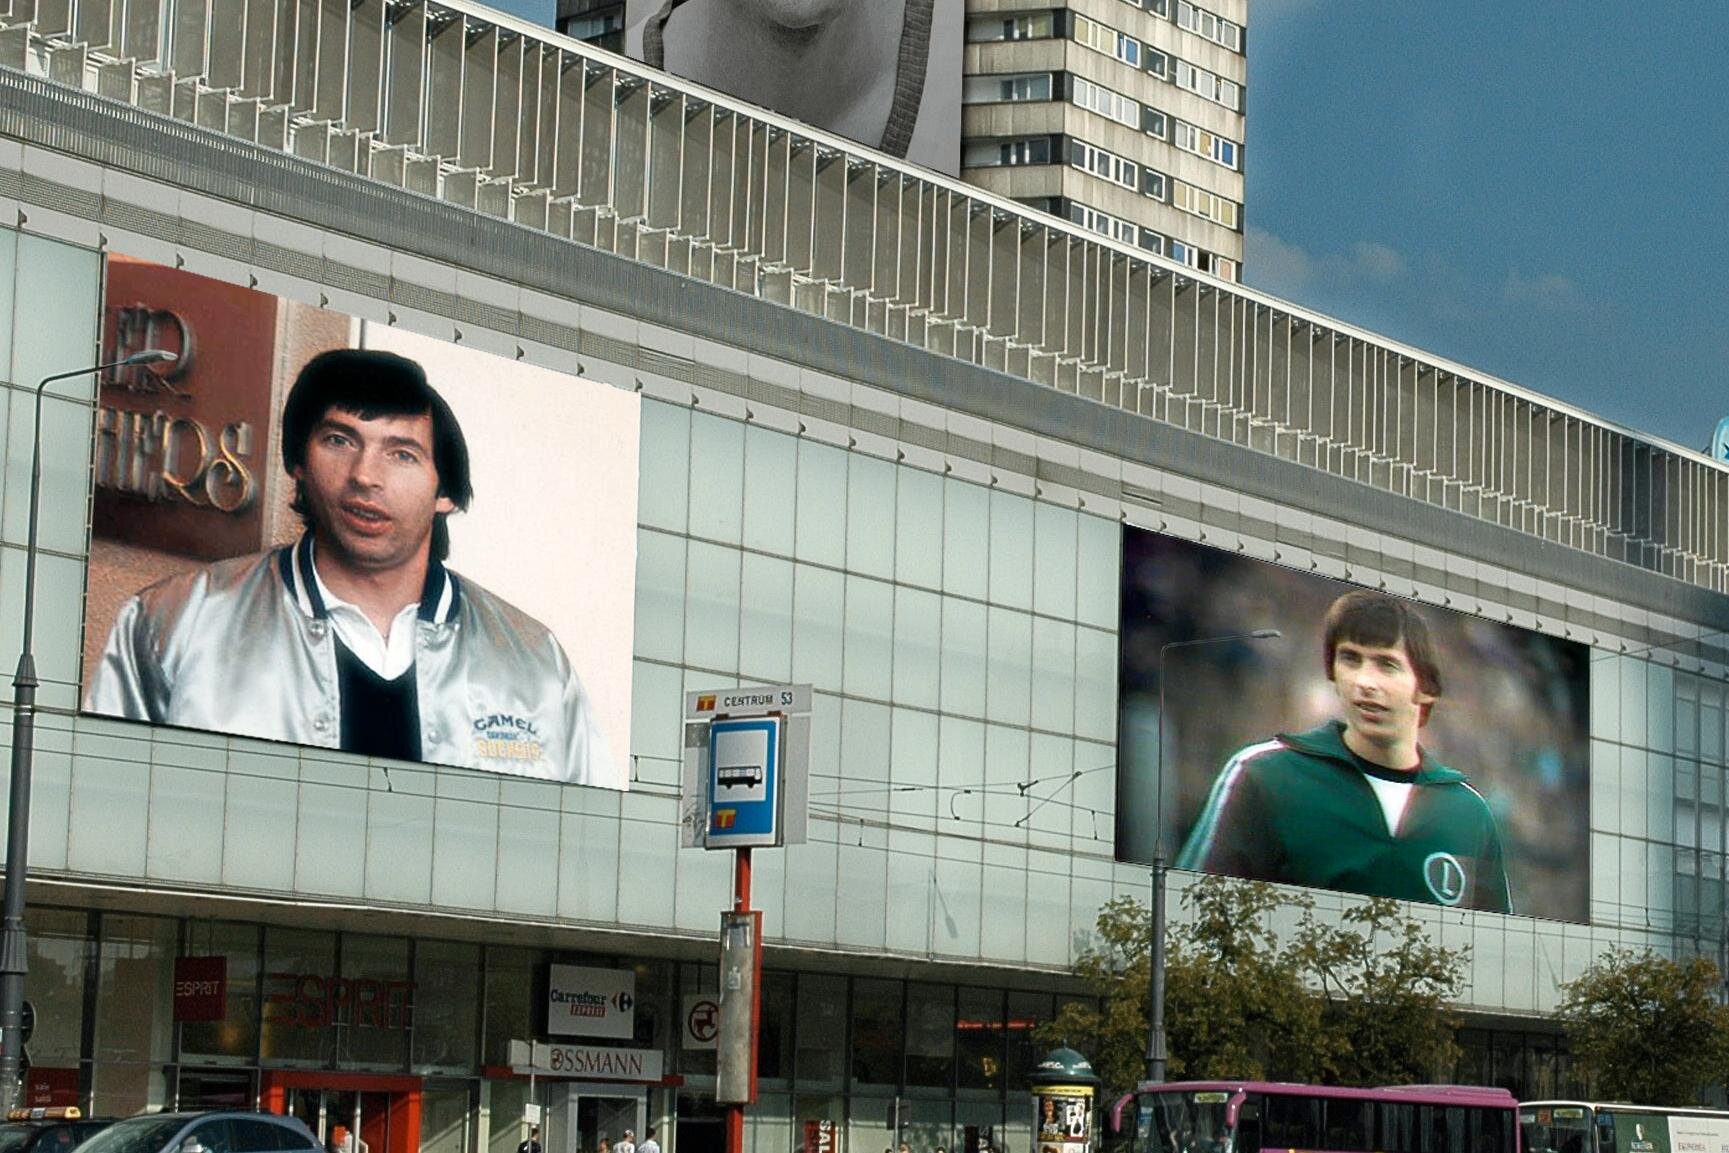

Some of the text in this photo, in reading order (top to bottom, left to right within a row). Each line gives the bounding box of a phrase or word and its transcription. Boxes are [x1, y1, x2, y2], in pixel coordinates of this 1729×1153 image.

[724, 695, 774, 707] CENTRUM
[781, 692, 793, 706] 53
[474, 714, 536, 735] CAMEL
[176, 981, 219, 997] ESPRIT
[267, 972, 417, 1030] ESPRIT
